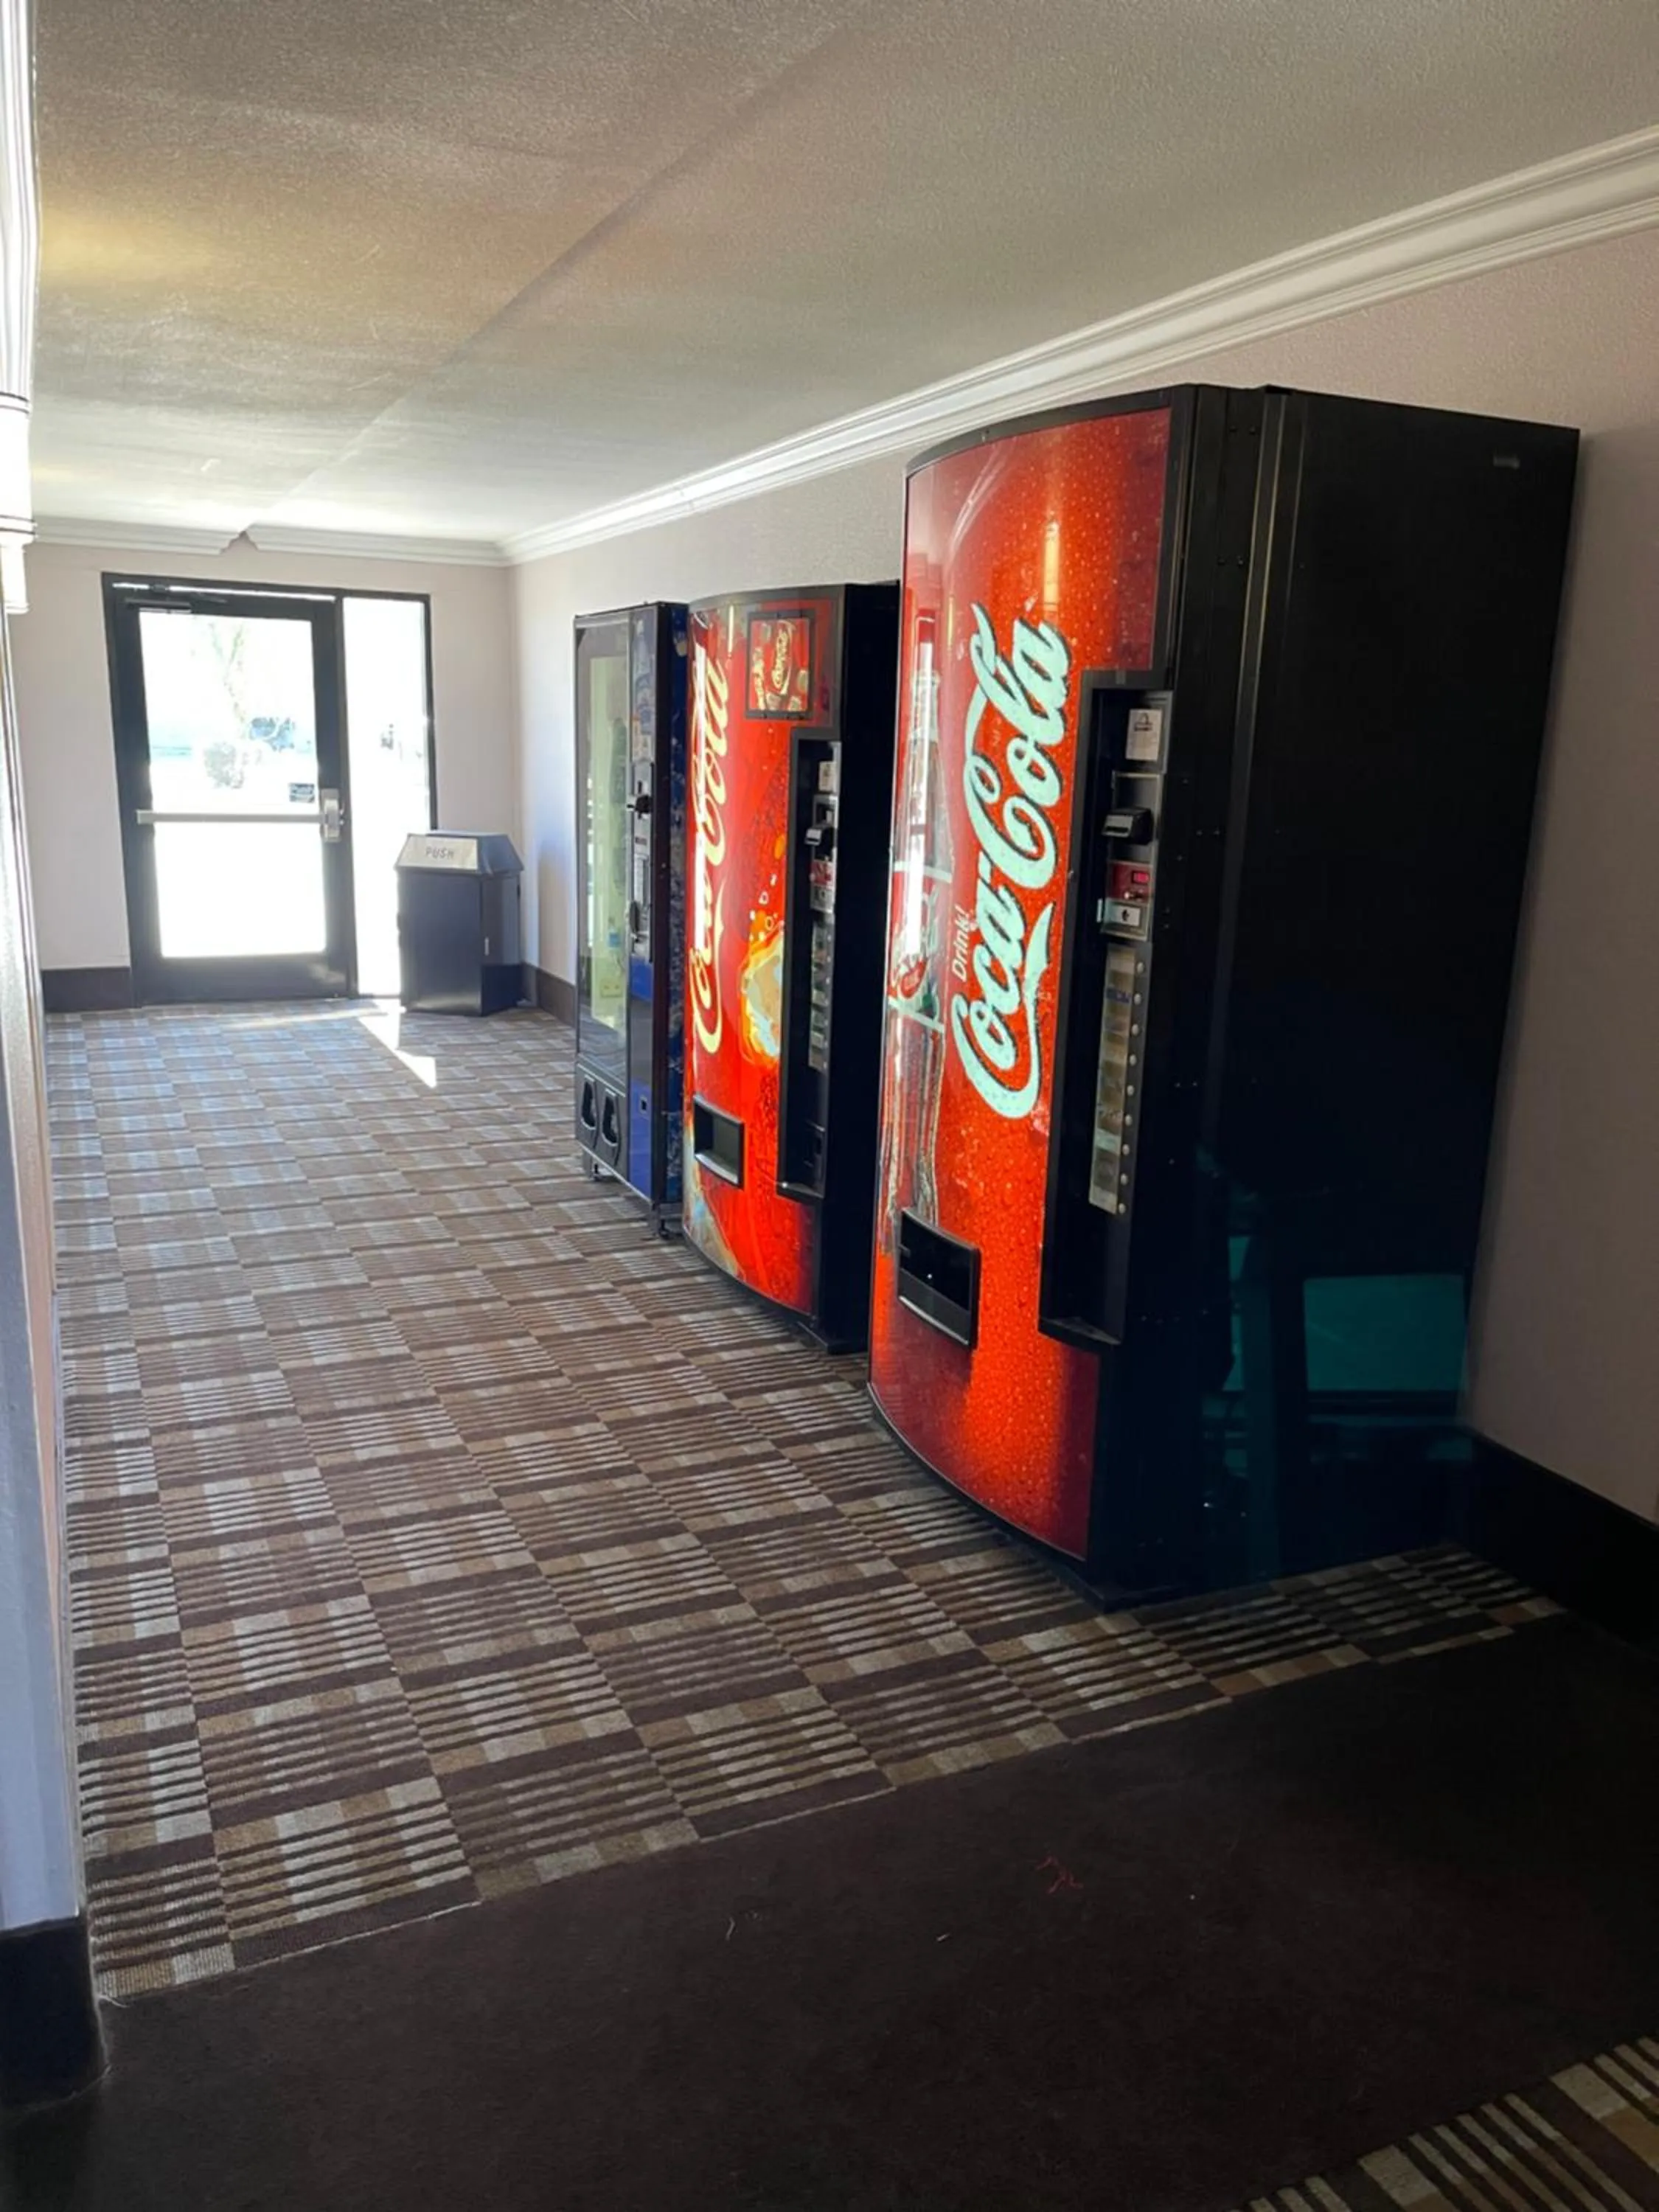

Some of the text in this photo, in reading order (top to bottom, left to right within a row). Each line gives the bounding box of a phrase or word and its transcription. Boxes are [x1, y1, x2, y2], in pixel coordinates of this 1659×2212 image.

[425, 846, 455, 860] PUSH
[689, 652, 728, 1054] CocaCola
[951, 602, 1071, 1119] Coca-Cola
[951, 904, 972, 982] Drink!
